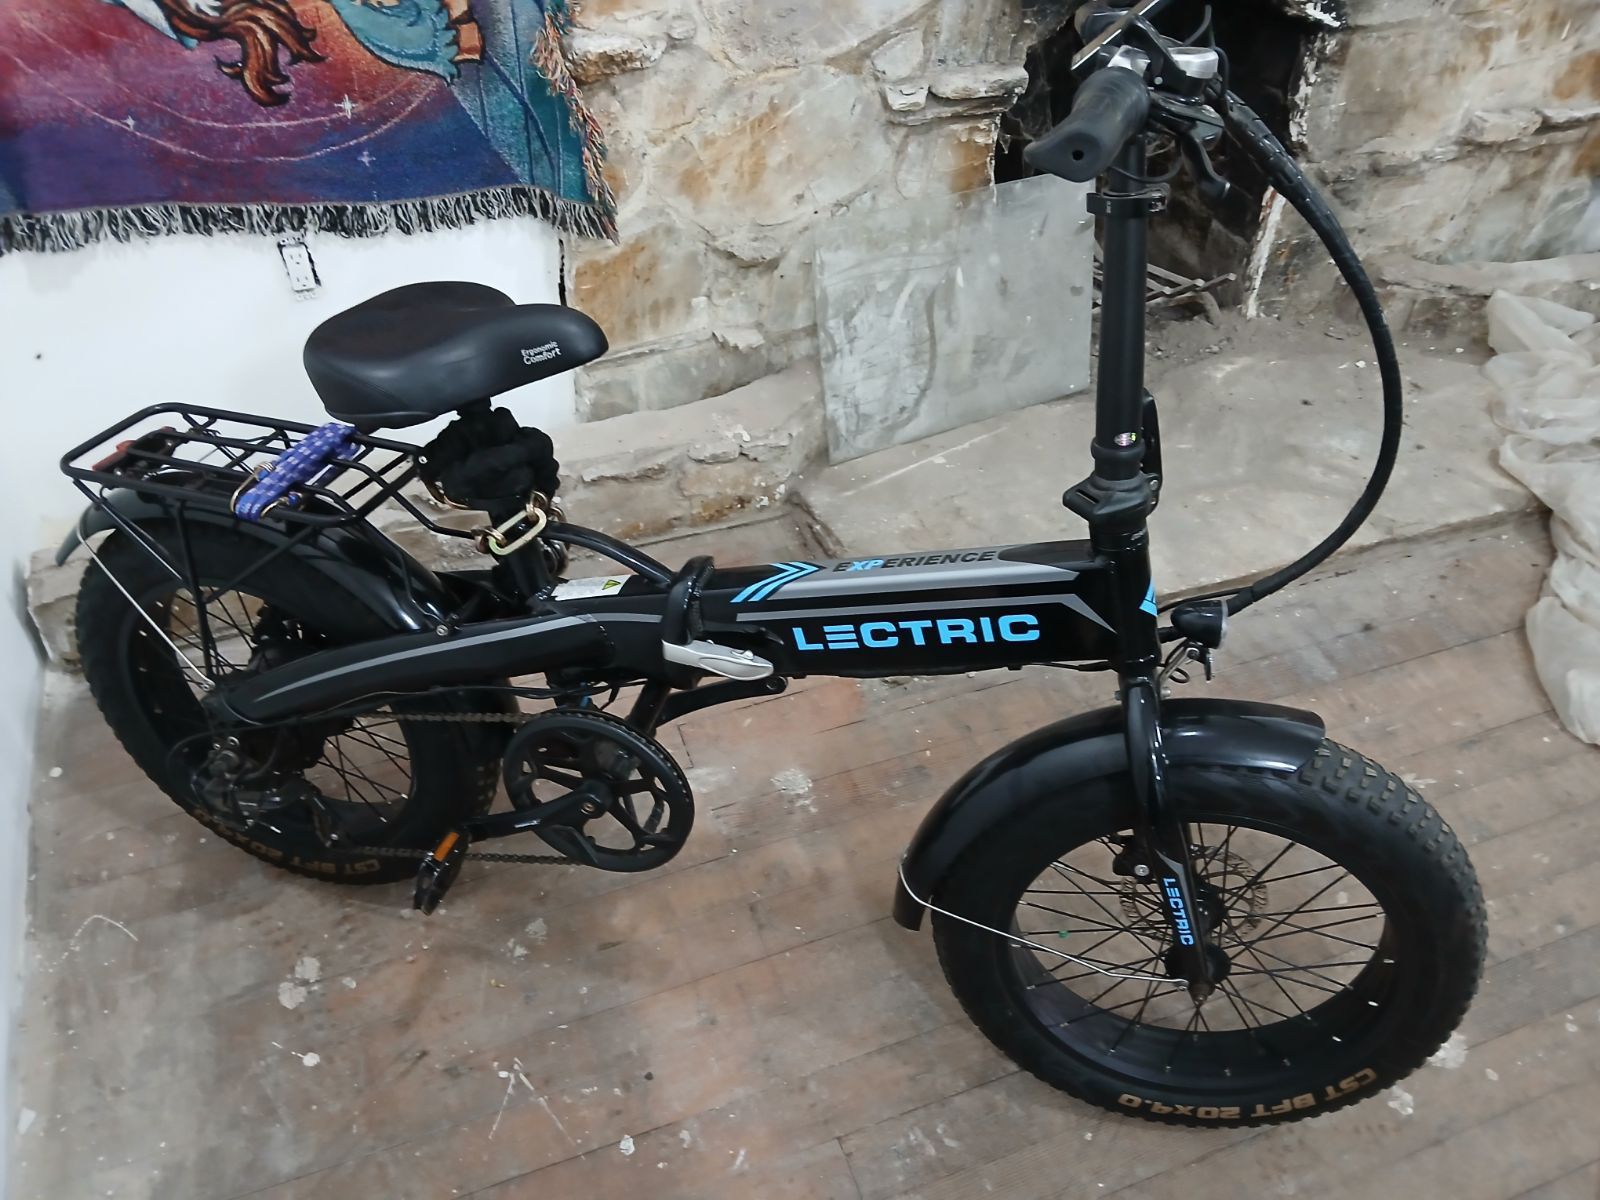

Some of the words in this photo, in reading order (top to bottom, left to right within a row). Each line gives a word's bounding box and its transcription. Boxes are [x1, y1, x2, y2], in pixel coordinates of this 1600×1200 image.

[521, 341, 558, 356] Ergonomic
[523, 348, 561, 365] Comfort
[832, 550, 997, 572] EXPERIENCE
[792, 614, 1040, 650] LECTRIC
[1163, 878, 1194, 945] LECTRIC
[1325, 1067, 1377, 1101] CST
[1251, 1093, 1316, 1118] BFT
